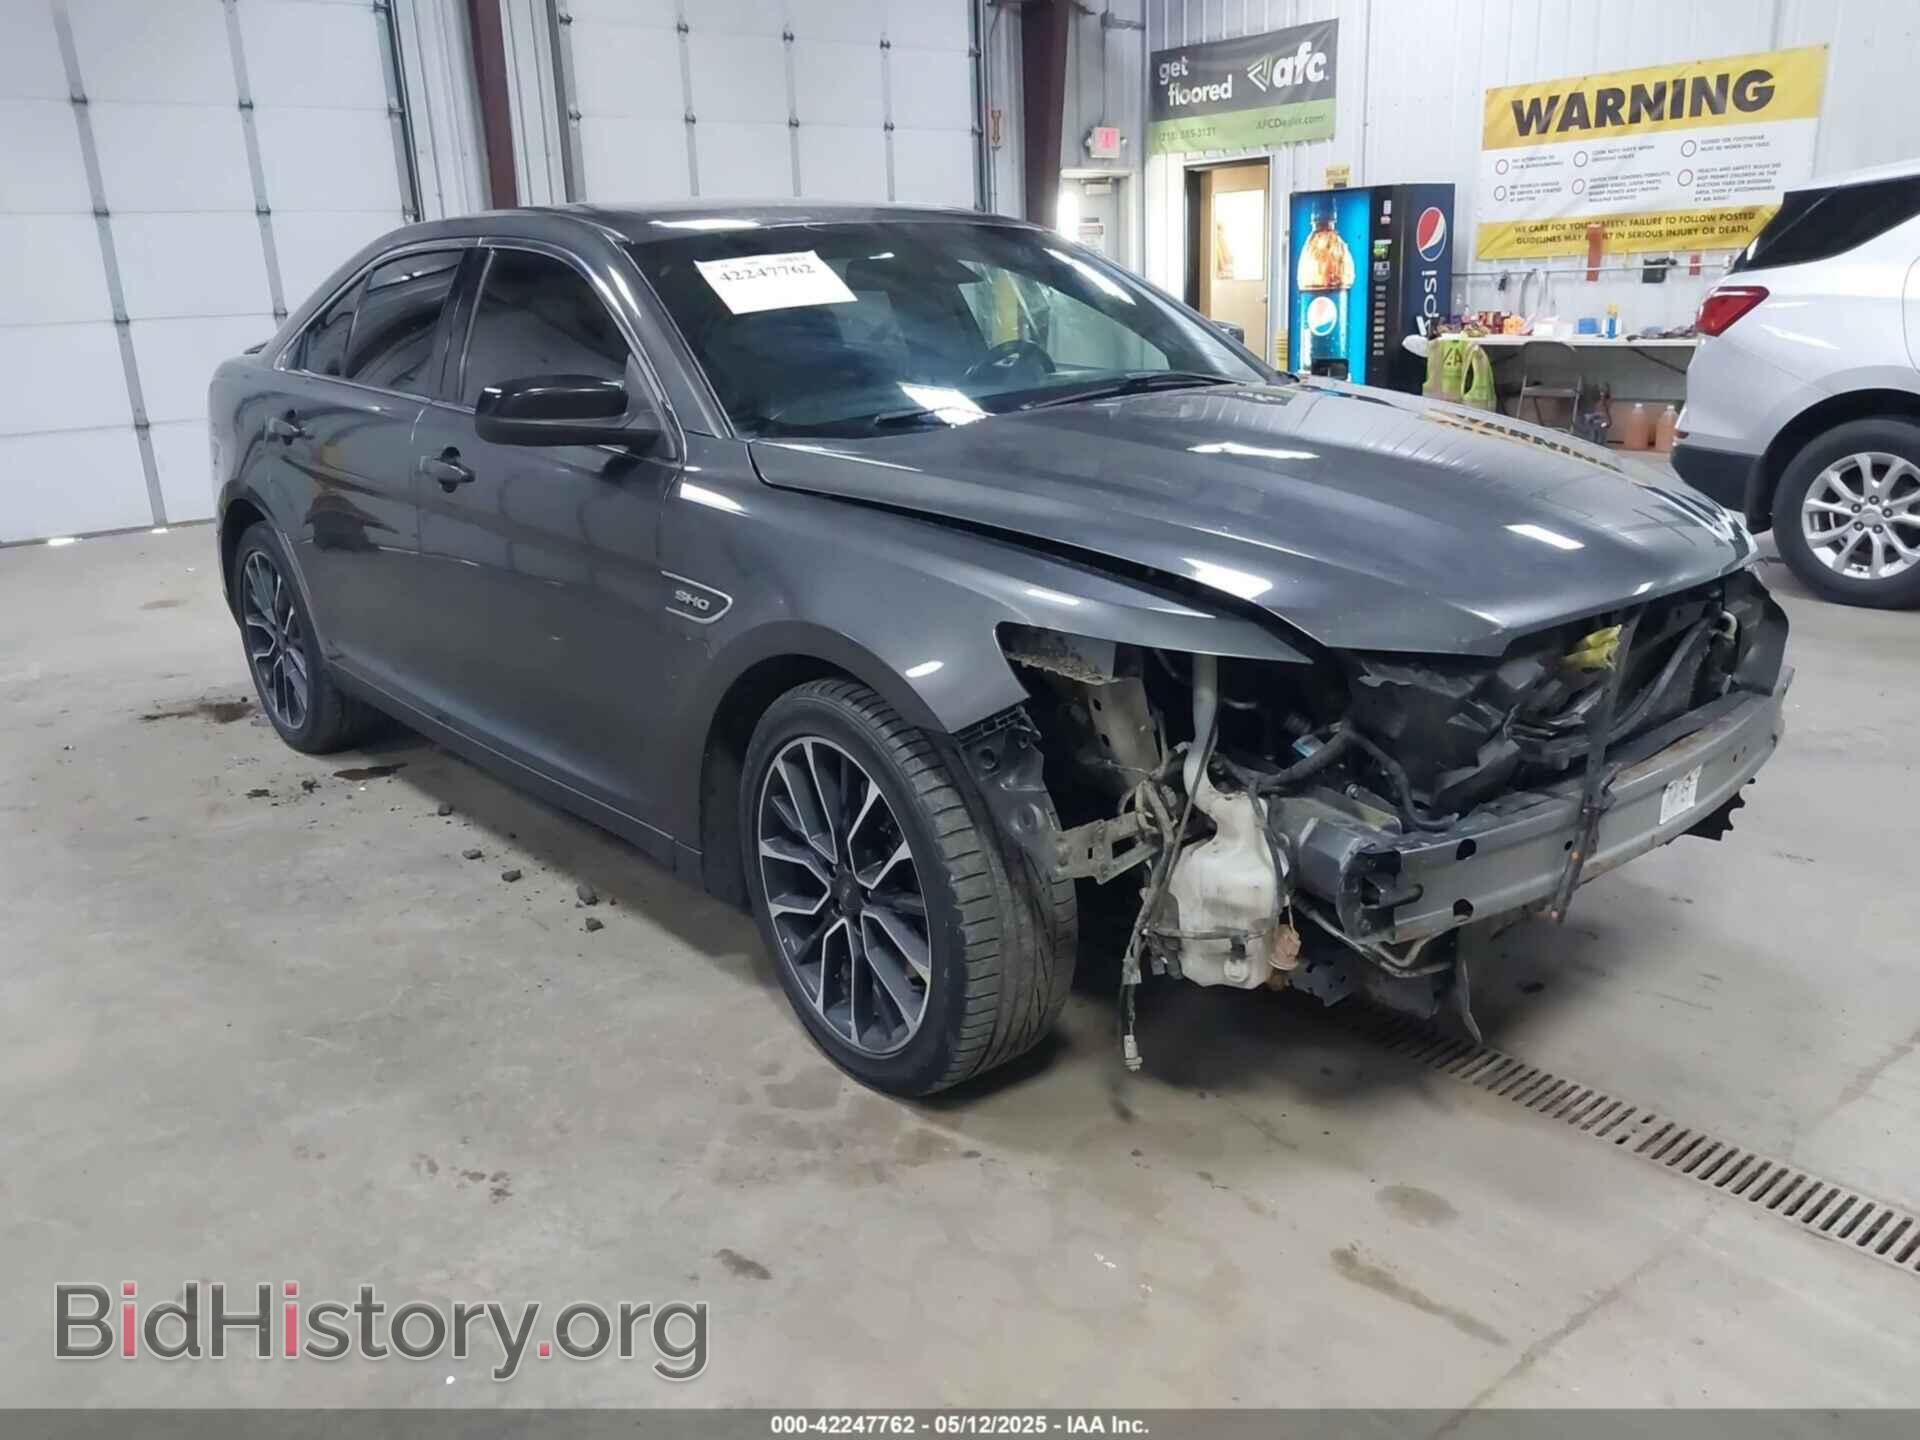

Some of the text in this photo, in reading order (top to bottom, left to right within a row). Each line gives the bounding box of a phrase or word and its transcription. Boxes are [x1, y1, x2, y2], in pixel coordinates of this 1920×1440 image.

[1159, 56, 1189, 86] get
[1272, 41, 1327, 88] afc
[1167, 74, 1233, 107] floored
[1511, 69, 1775, 136] WARNING
[1528, 223, 1549, 233] CARE
[1551, 223, 1567, 232] FOR
[1629, 216, 1662, 226] FAILURE
[1665, 216, 1677, 225] TO
[1679, 214, 1716, 224] FOLLOW
[1720, 211, 1756, 221] POSTED
[1516, 235, 1562, 245] GUIDELINES
[1615, 232, 1625, 240] IN
[1627, 230, 1663, 239] SERIOUS
[1666, 228, 1698, 237] INJURY
[1702, 226, 1716, 235] OR
[719, 264, 816, 282] 42247762
[675, 590, 710, 611] SHO
